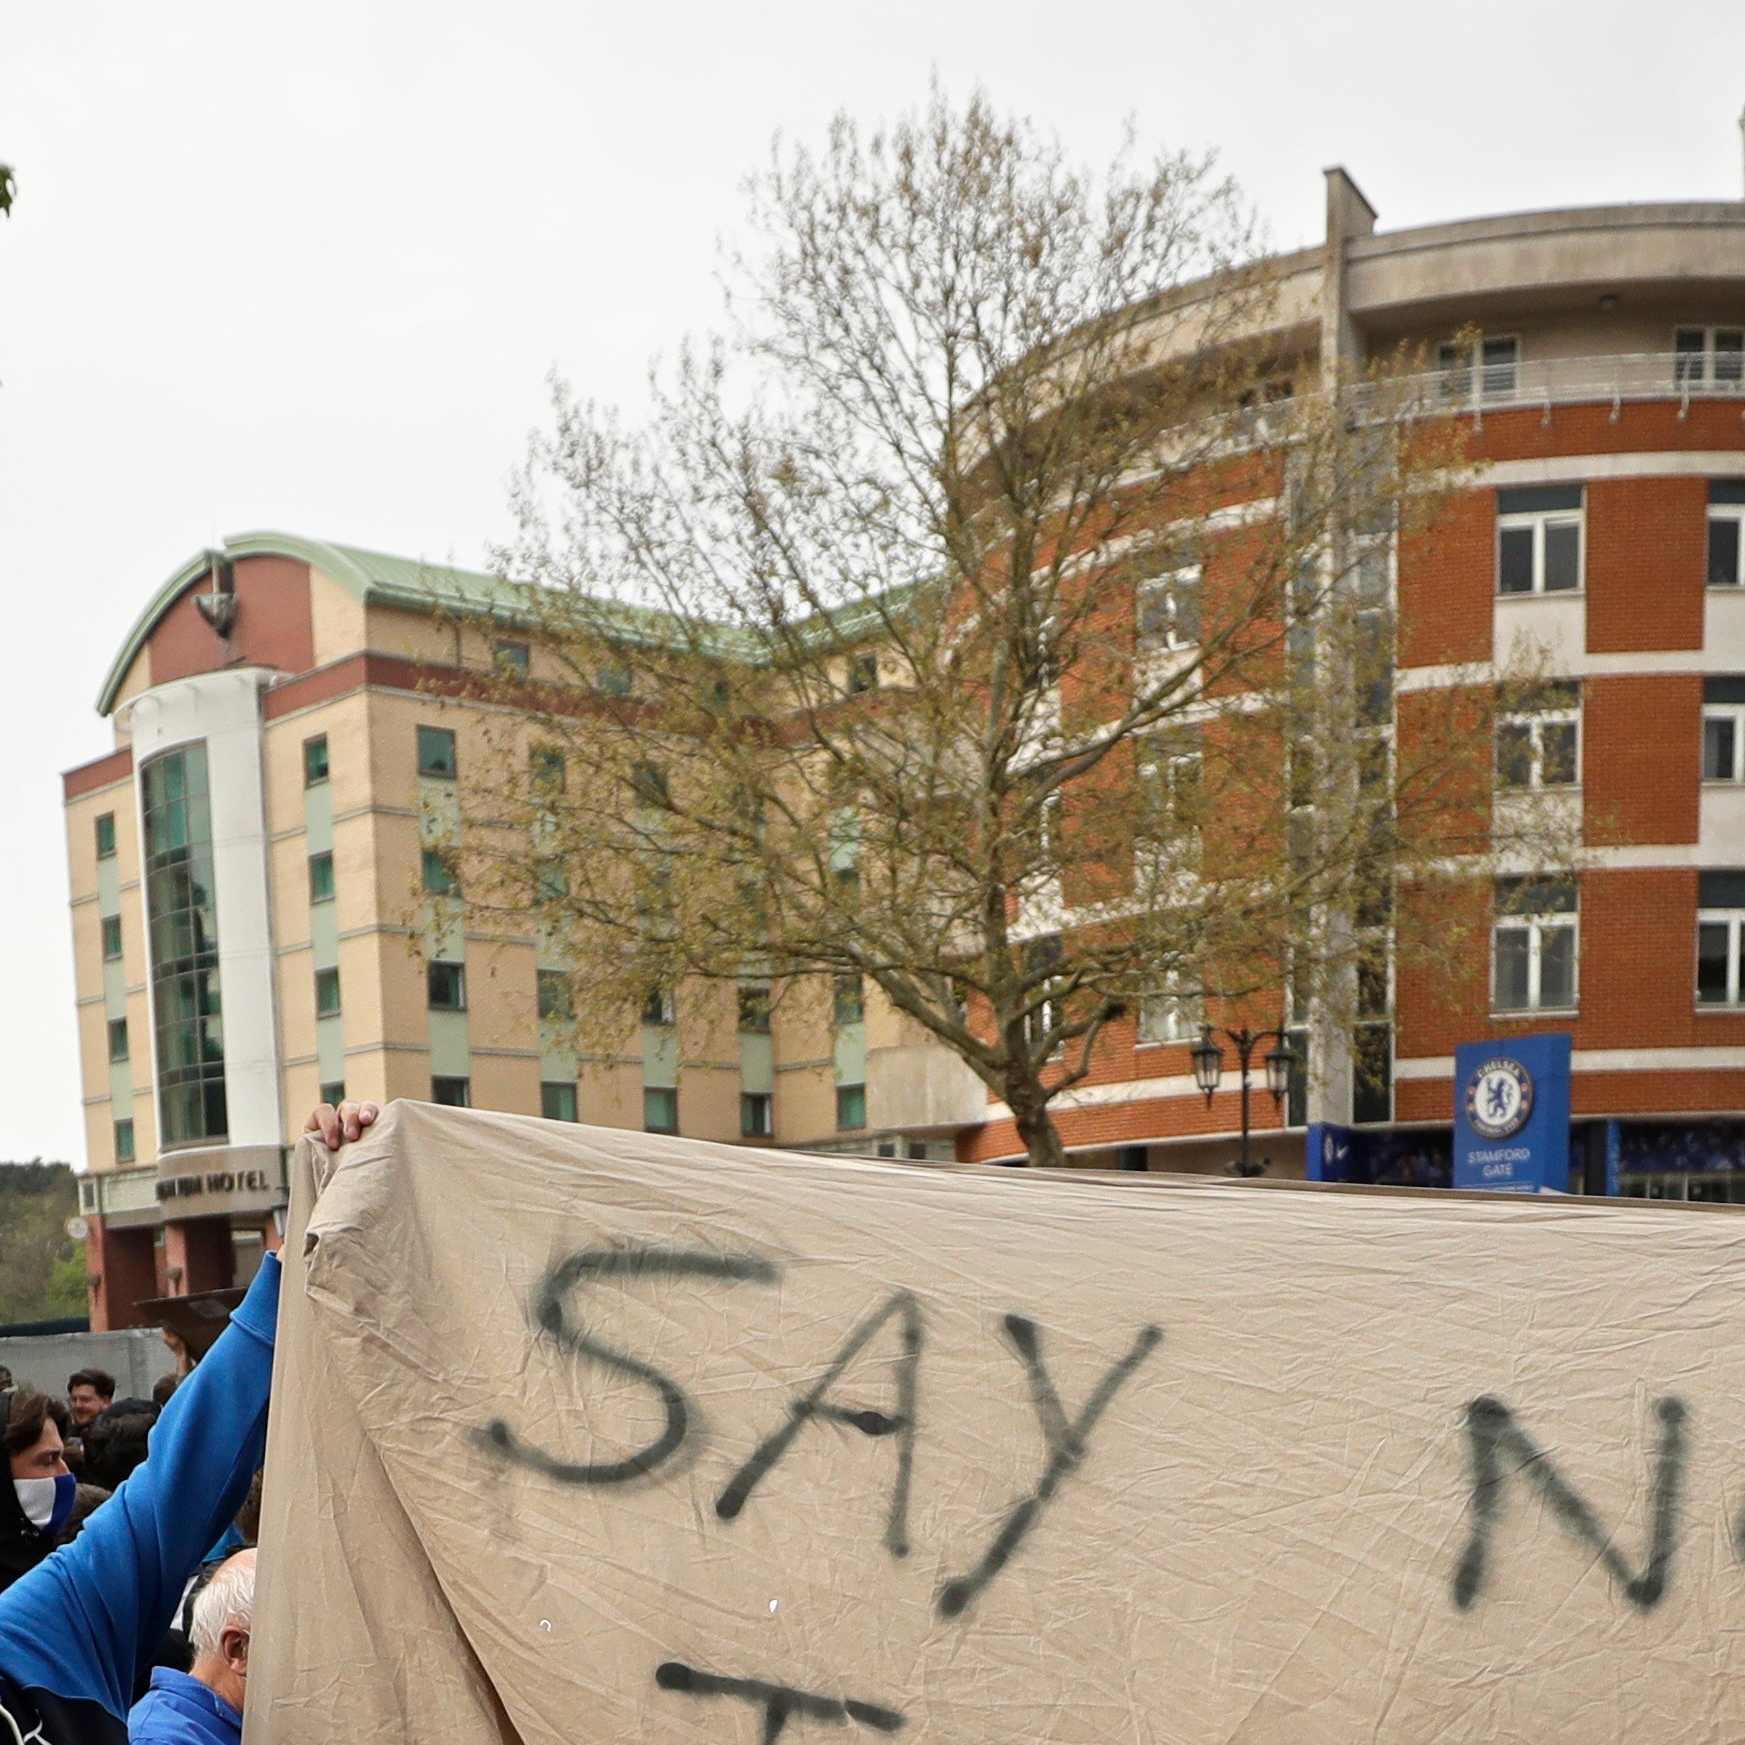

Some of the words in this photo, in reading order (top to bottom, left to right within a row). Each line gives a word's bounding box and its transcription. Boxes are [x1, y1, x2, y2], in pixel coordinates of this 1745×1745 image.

[1477, 1060, 1520, 1078] CHELSEA
[1467, 1148, 1531, 1164] STAMFORD
[1482, 1163, 1513, 1178] GATE
[206, 1171, 269, 1193] HOTEL
[477, 1246, 1163, 1618] SAY
